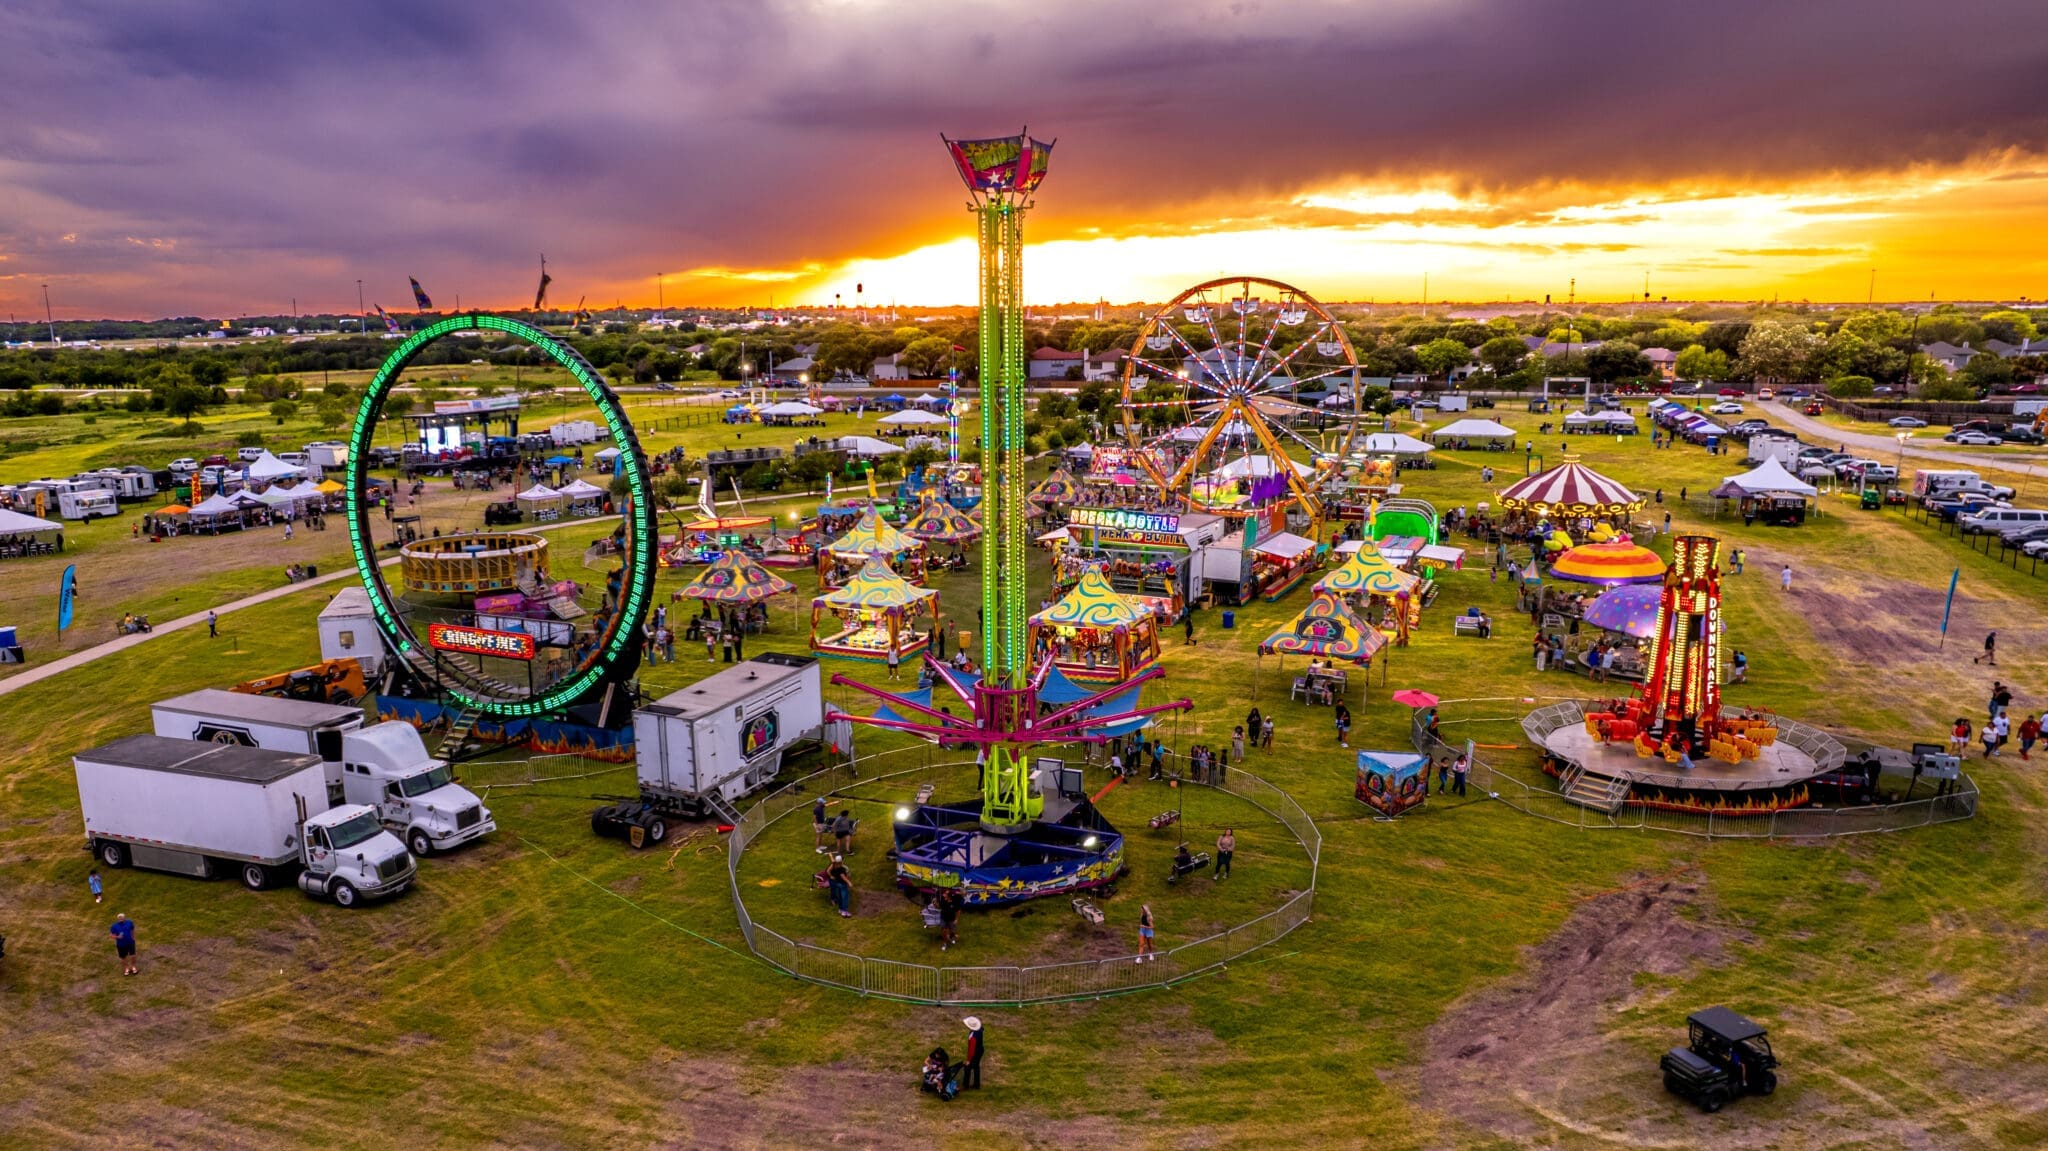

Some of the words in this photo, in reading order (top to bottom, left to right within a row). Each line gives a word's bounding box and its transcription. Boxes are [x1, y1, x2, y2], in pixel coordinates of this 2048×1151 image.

[1070, 509, 1115, 527] BREAK
[1115, 509, 1127, 529] A
[1127, 513, 1178, 532] BOTTLE
[446, 630, 477, 646] RING
[1707, 597, 1717, 705] DOWNDRAFT
